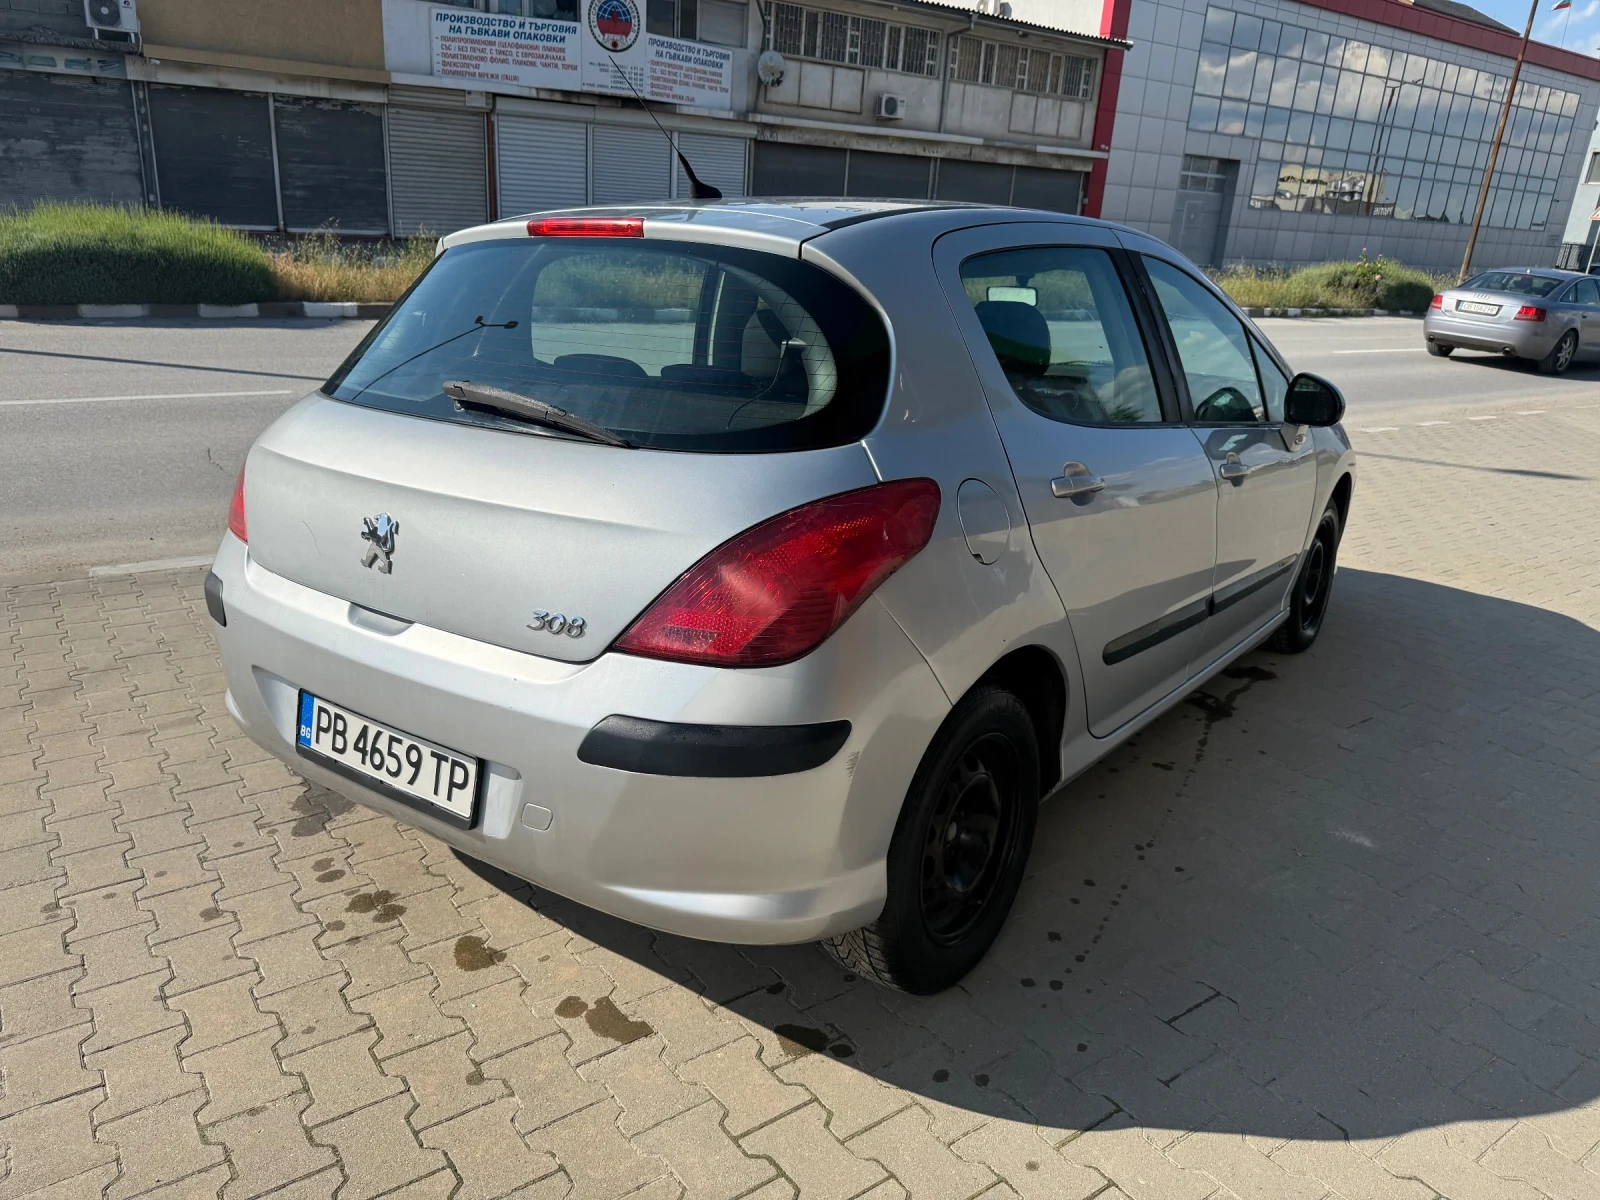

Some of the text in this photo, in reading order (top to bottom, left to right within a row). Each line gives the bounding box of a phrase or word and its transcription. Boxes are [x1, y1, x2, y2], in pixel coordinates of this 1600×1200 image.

[436, 13, 577, 35] ПРОИЗВОДСТВО И ТЪРГОВИЯ
[449, 25, 566, 44] НА ГЪВКАВИ ОПАКОВКИ
[458, 45, 468, 53] БЕЗ
[648, 37, 731, 61] ПРОИЗВОДСТВО И ТЪРГОВИЯ
[655, 49, 724, 69] НА ГЪВКАВИ ОПАКОВКИ
[526, 608, 588, 638] 308
[300, 724, 311, 739] BG
[314, 704, 470, 802] PB 4659 TP
